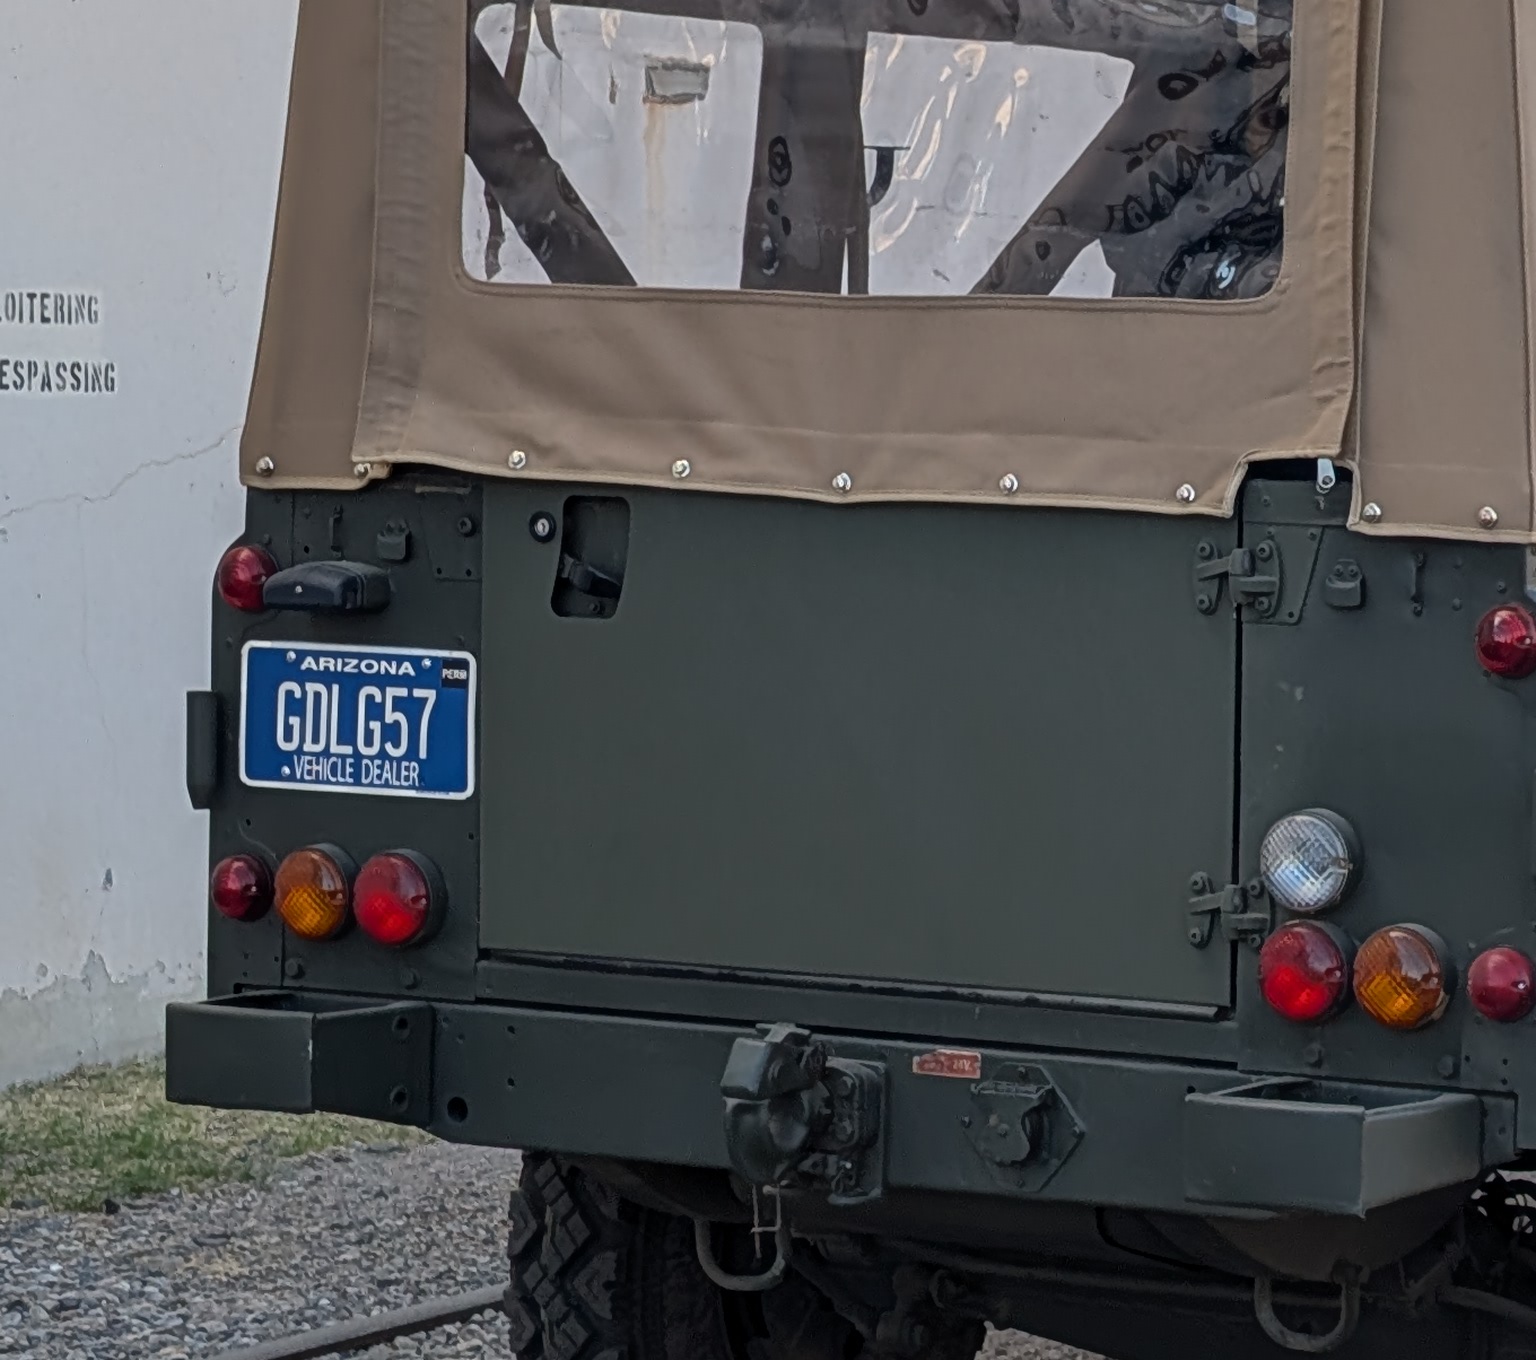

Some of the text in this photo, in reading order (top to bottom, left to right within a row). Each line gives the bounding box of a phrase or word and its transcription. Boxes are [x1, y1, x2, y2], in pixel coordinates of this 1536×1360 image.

[0, 291, 99, 326] OITERING
[300, 656, 416, 677] ARIZONA
[276, 681, 437, 760] GDLG57
[293, 755, 420, 787] VEHICLE DEALER
